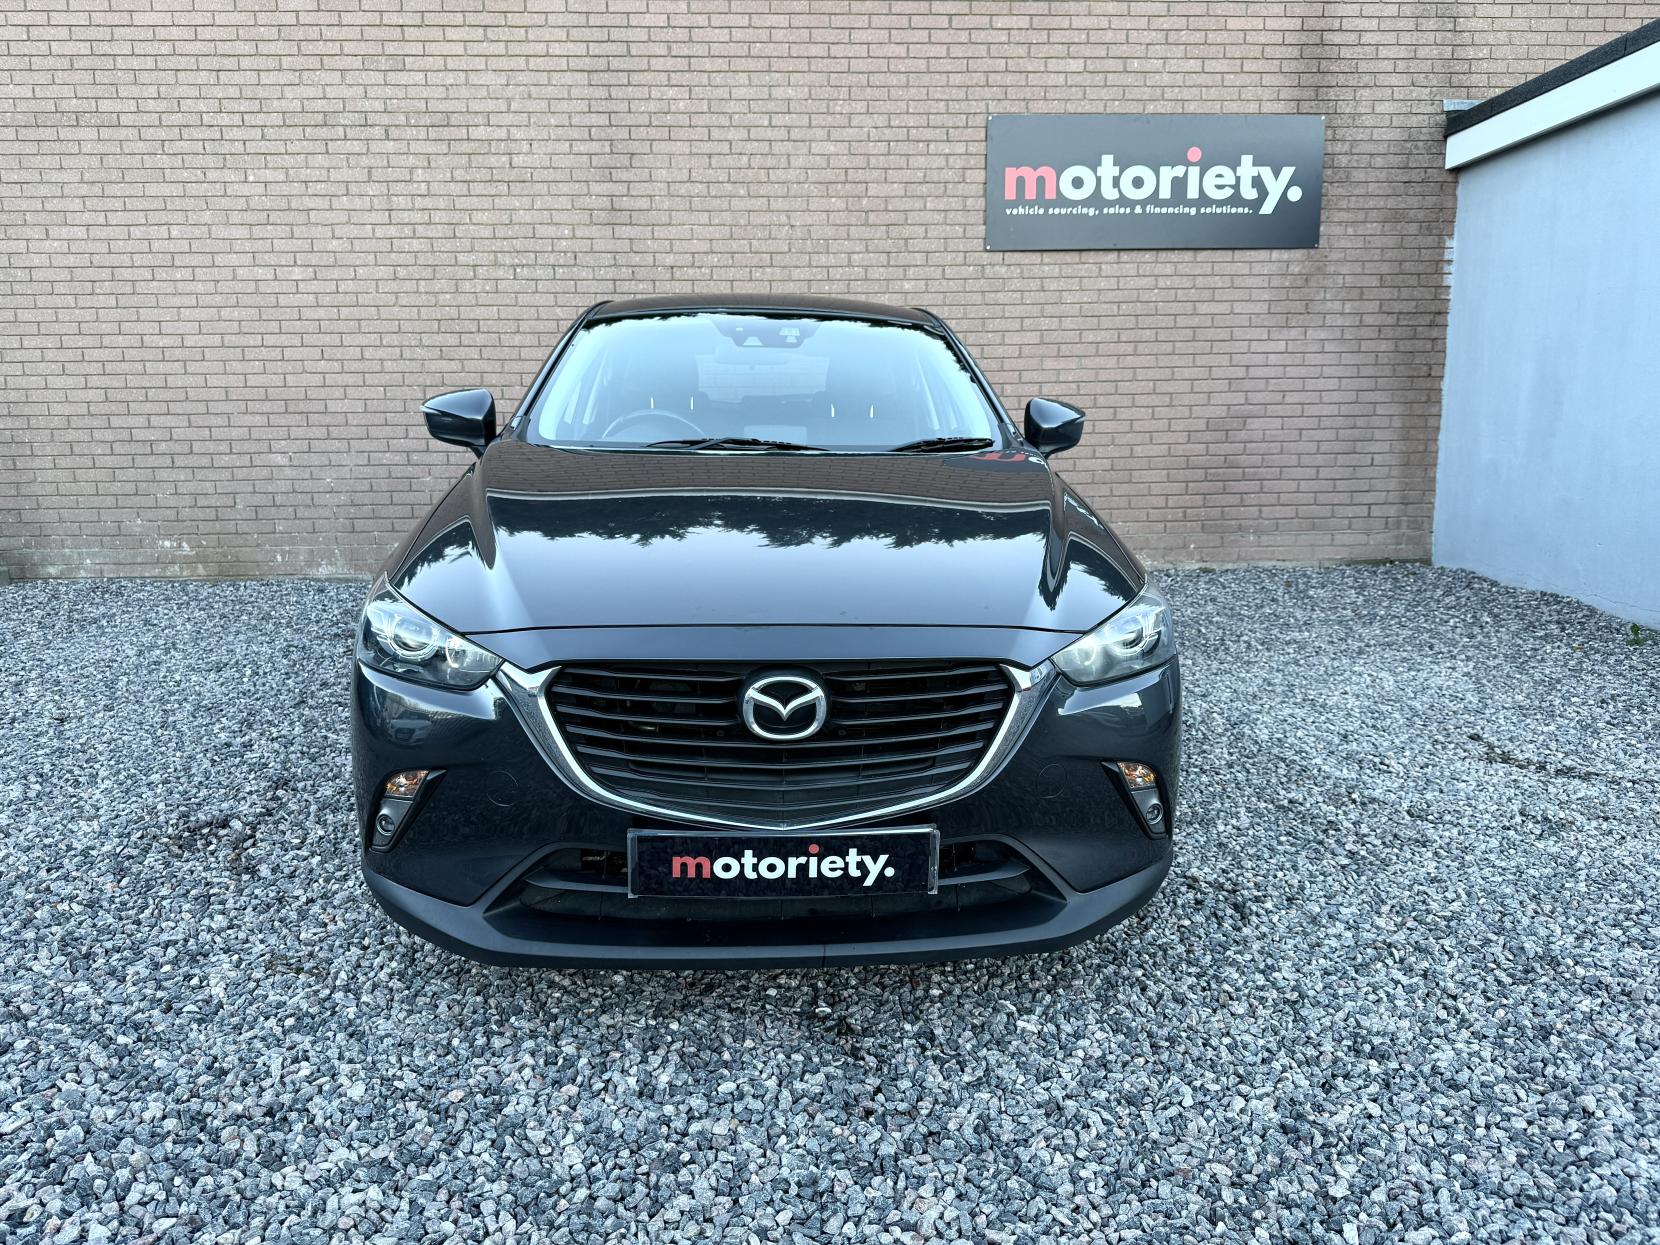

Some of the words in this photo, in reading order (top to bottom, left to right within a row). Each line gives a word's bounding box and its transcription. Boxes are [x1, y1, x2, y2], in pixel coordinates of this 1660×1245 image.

[1004, 146, 1303, 215] motoriety.
[1005, 204, 1045, 215] vehicle
[1048, 204, 1099, 216] sourcing,
[1102, 204, 1131, 214] sales
[1134, 204, 1143, 214] &
[1145, 204, 1197, 216] financing
[1200, 204, 1253, 214] solutions.
[671, 843, 896, 887] motoriety.
